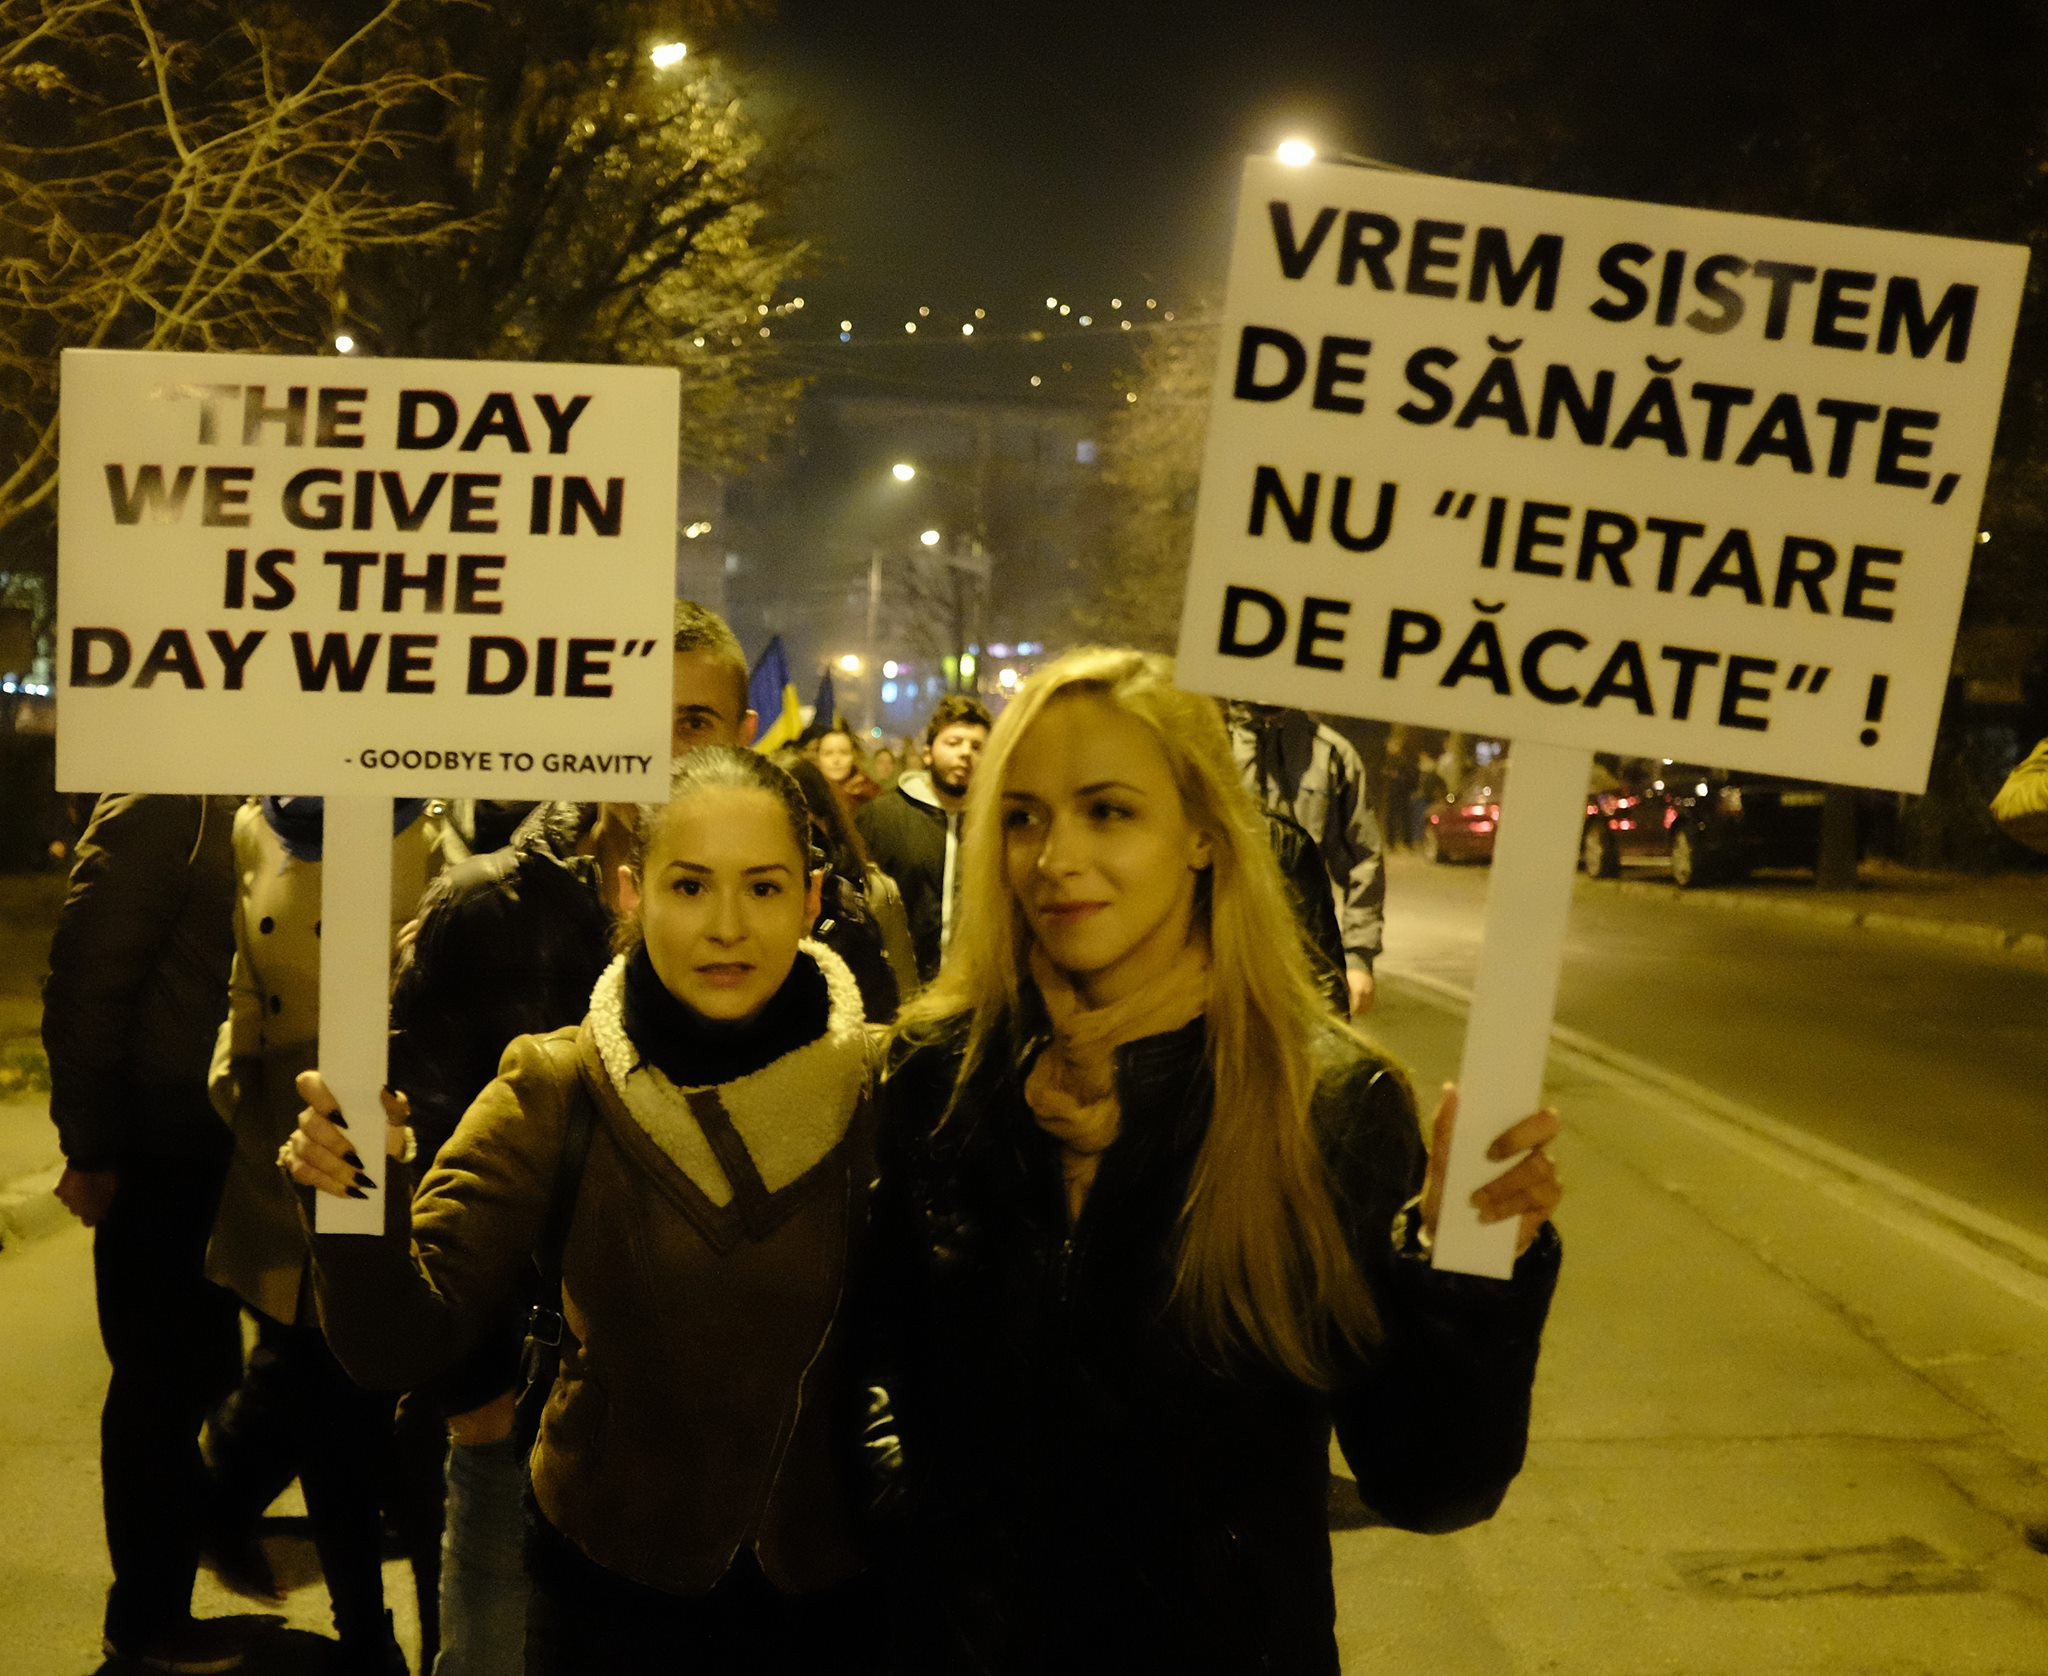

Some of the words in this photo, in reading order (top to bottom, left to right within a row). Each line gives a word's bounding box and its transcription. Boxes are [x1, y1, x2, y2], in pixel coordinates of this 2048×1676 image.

[1268, 200, 1565, 313] VREM
[1588, 240, 1980, 365] SISTEM
[396, 389, 592, 455] DAY
[1232, 324, 1373, 416] DE
[1396, 332, 1962, 506] SĂNĂTATE,
[104, 463, 255, 528] WE
[281, 467, 502, 534] GIVE
[529, 474, 625, 537] IN
[1247, 464, 1398, 554] NU
[223, 548, 296, 612] IS
[323, 550, 507, 615] THE
[68, 626, 268, 691] DAY
[289, 631, 439, 695] WE
[1217, 584, 1352, 673] DE
[1859, 673, 1890, 748] !
[359, 749, 492, 771] GOODBYE
[499, 752, 534, 772] TO
[542, 753, 652, 774] GRAVITY
